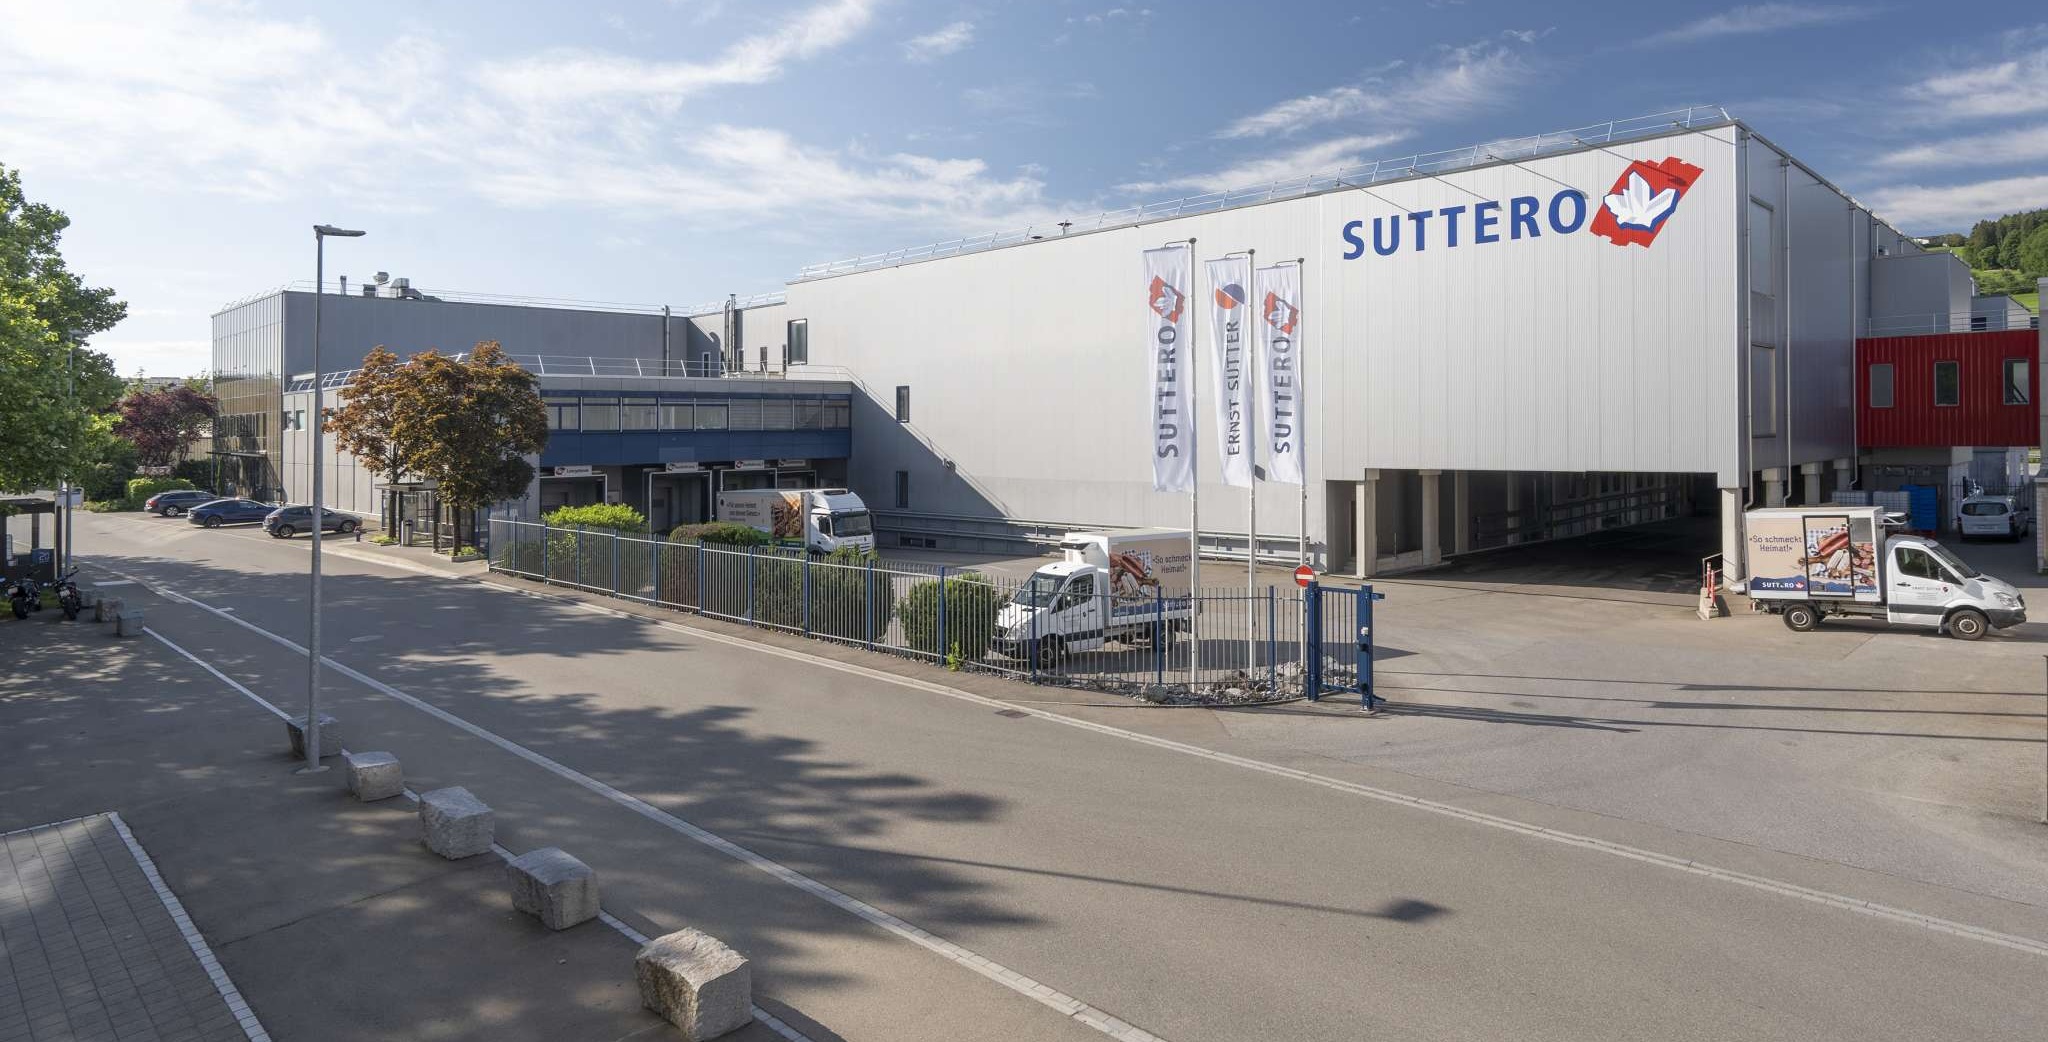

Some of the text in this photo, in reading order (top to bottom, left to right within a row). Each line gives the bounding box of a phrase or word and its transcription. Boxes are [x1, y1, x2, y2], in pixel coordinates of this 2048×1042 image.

[1342, 189, 1587, 260] SUTTERO
[1157, 325, 1179, 458] SUTTERO
[1225, 320, 1241, 456] ERNST SUTTER
[1272, 336, 1293, 454] SUTTERO
[1764, 535, 1803, 543] schmeckt
